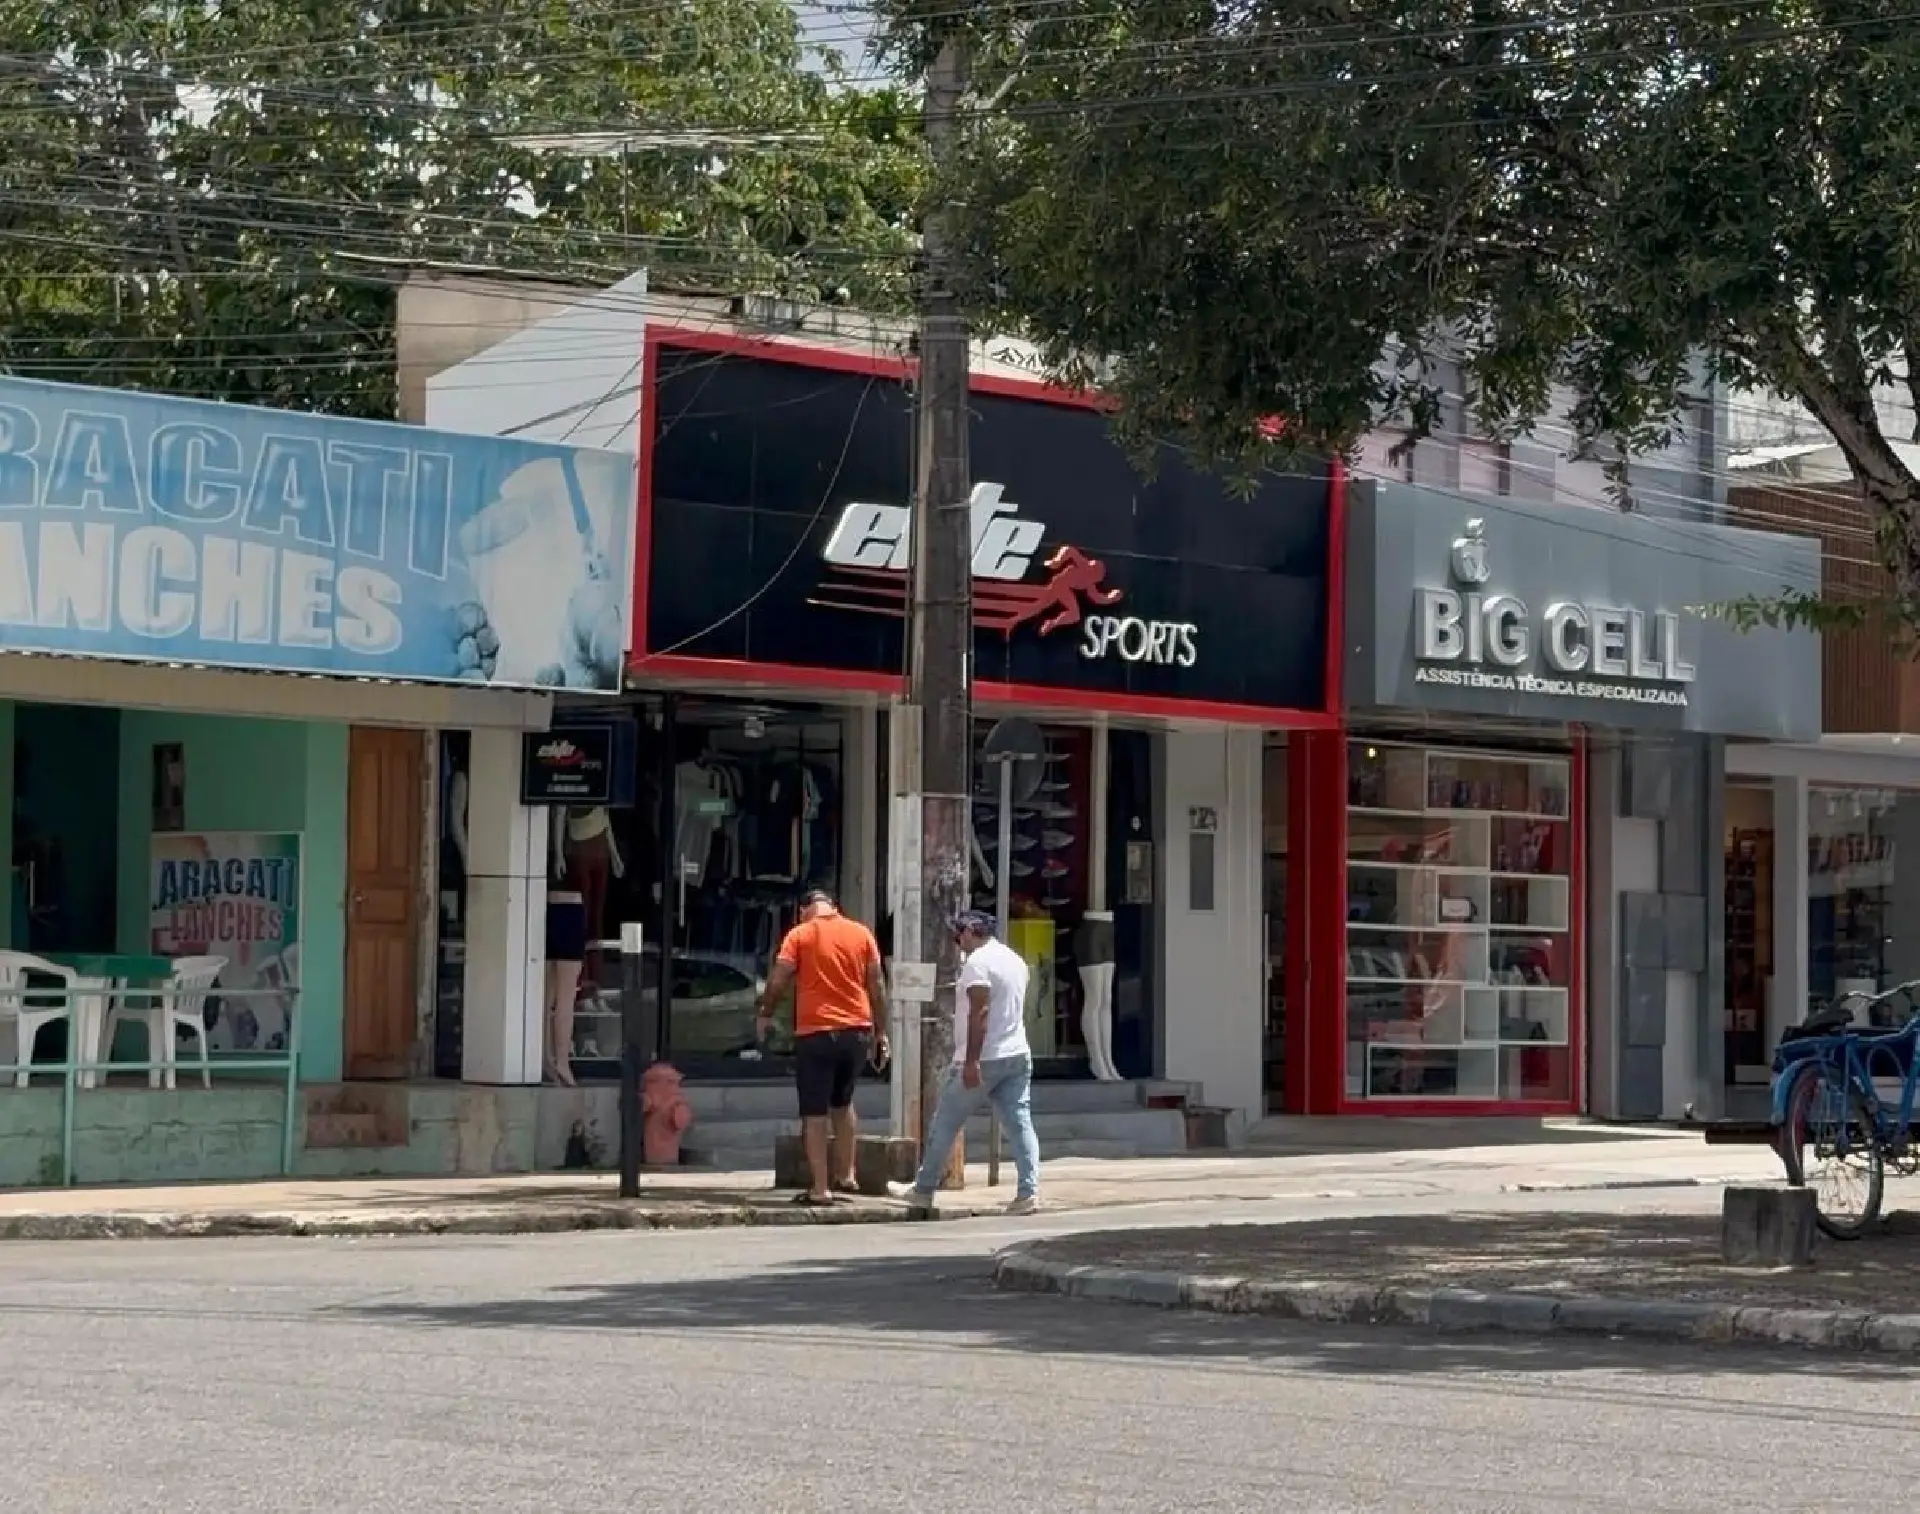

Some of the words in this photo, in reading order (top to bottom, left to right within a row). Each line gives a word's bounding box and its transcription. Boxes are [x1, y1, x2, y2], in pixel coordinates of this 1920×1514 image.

[1080, 615, 1198, 667] SPORTS
[1414, 586, 1529, 666] BIG
[1544, 602, 1695, 681] CELL
[1415, 667, 1515, 690] ASSISTÊNCIA
[1516, 673, 1575, 695] TÉCNICA
[1576, 682, 1688, 706] ESPECIALIZADA
[153, 857, 296, 910] ARACATI
[170, 902, 283, 942] LANCHES
